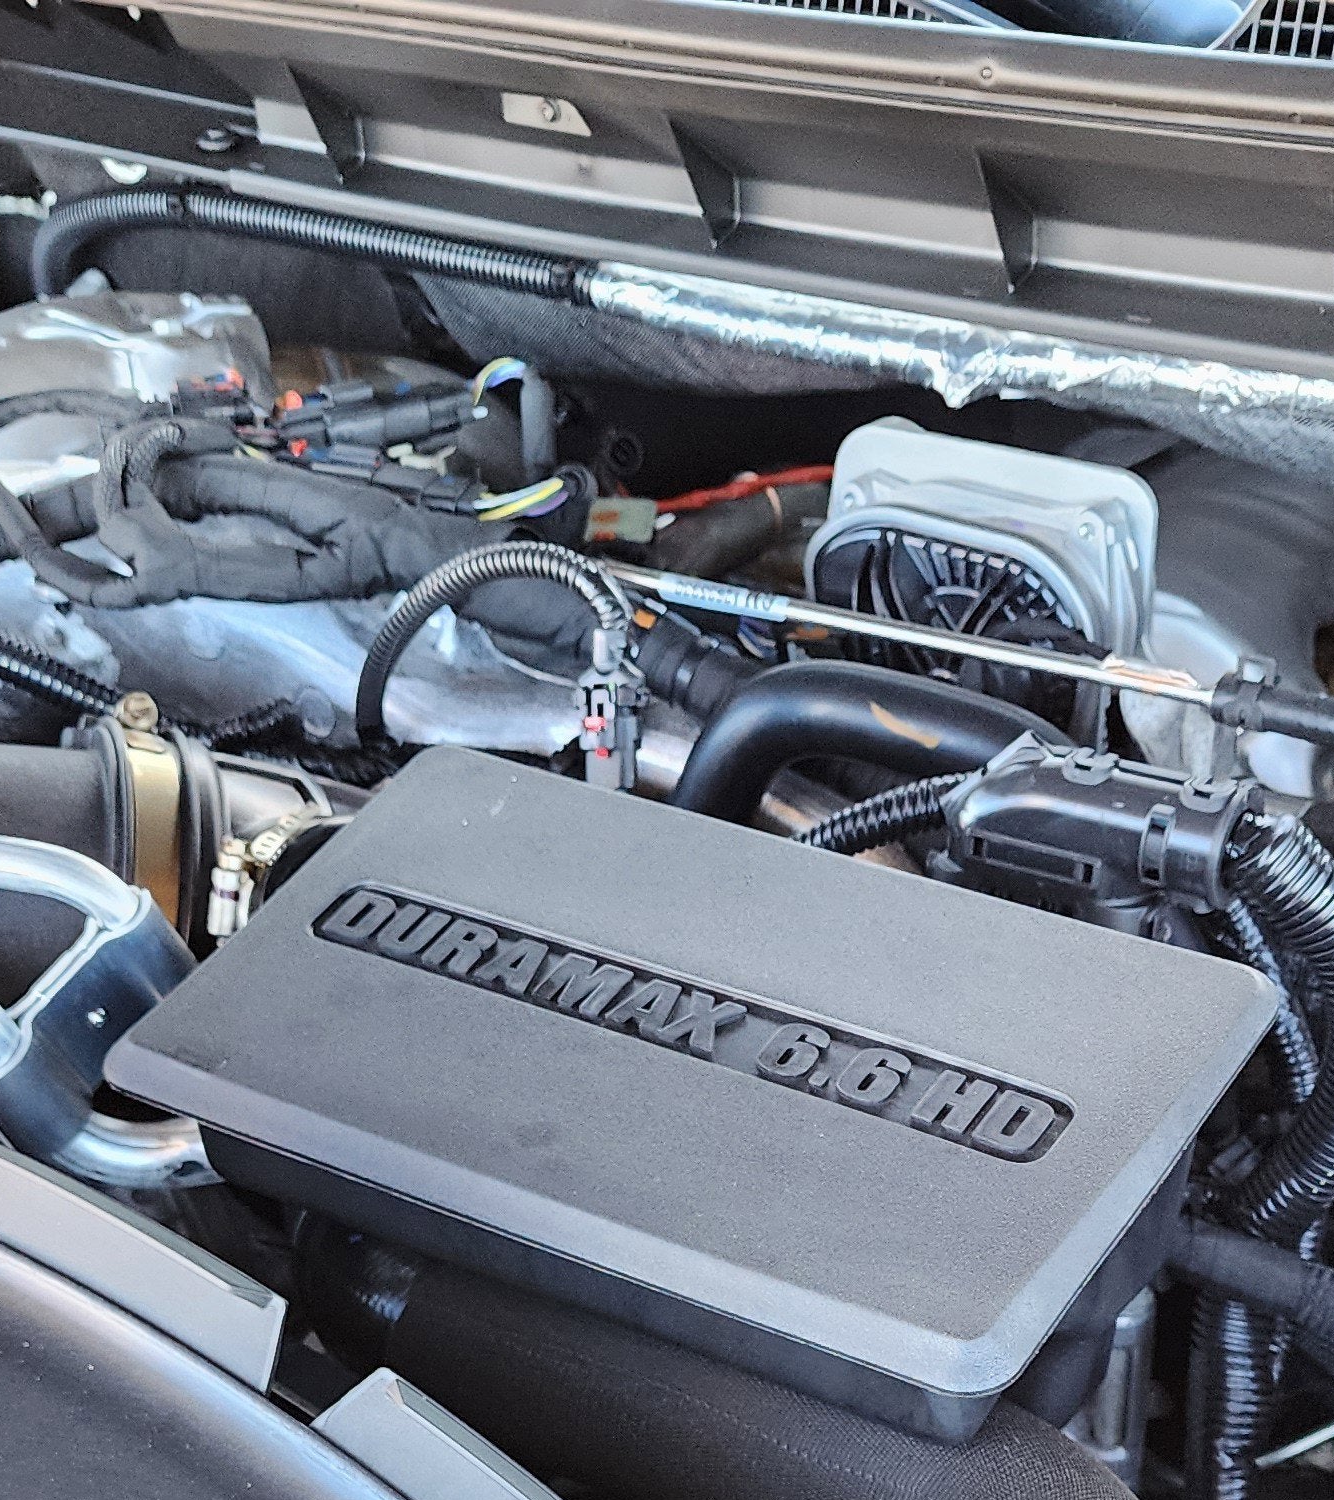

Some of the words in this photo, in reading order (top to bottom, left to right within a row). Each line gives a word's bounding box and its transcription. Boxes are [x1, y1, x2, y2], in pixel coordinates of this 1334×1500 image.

[320, 888, 747, 1055] DURAMAX
[757, 1023, 913, 1109] 6.6
[910, 1068, 1063, 1156] HD
